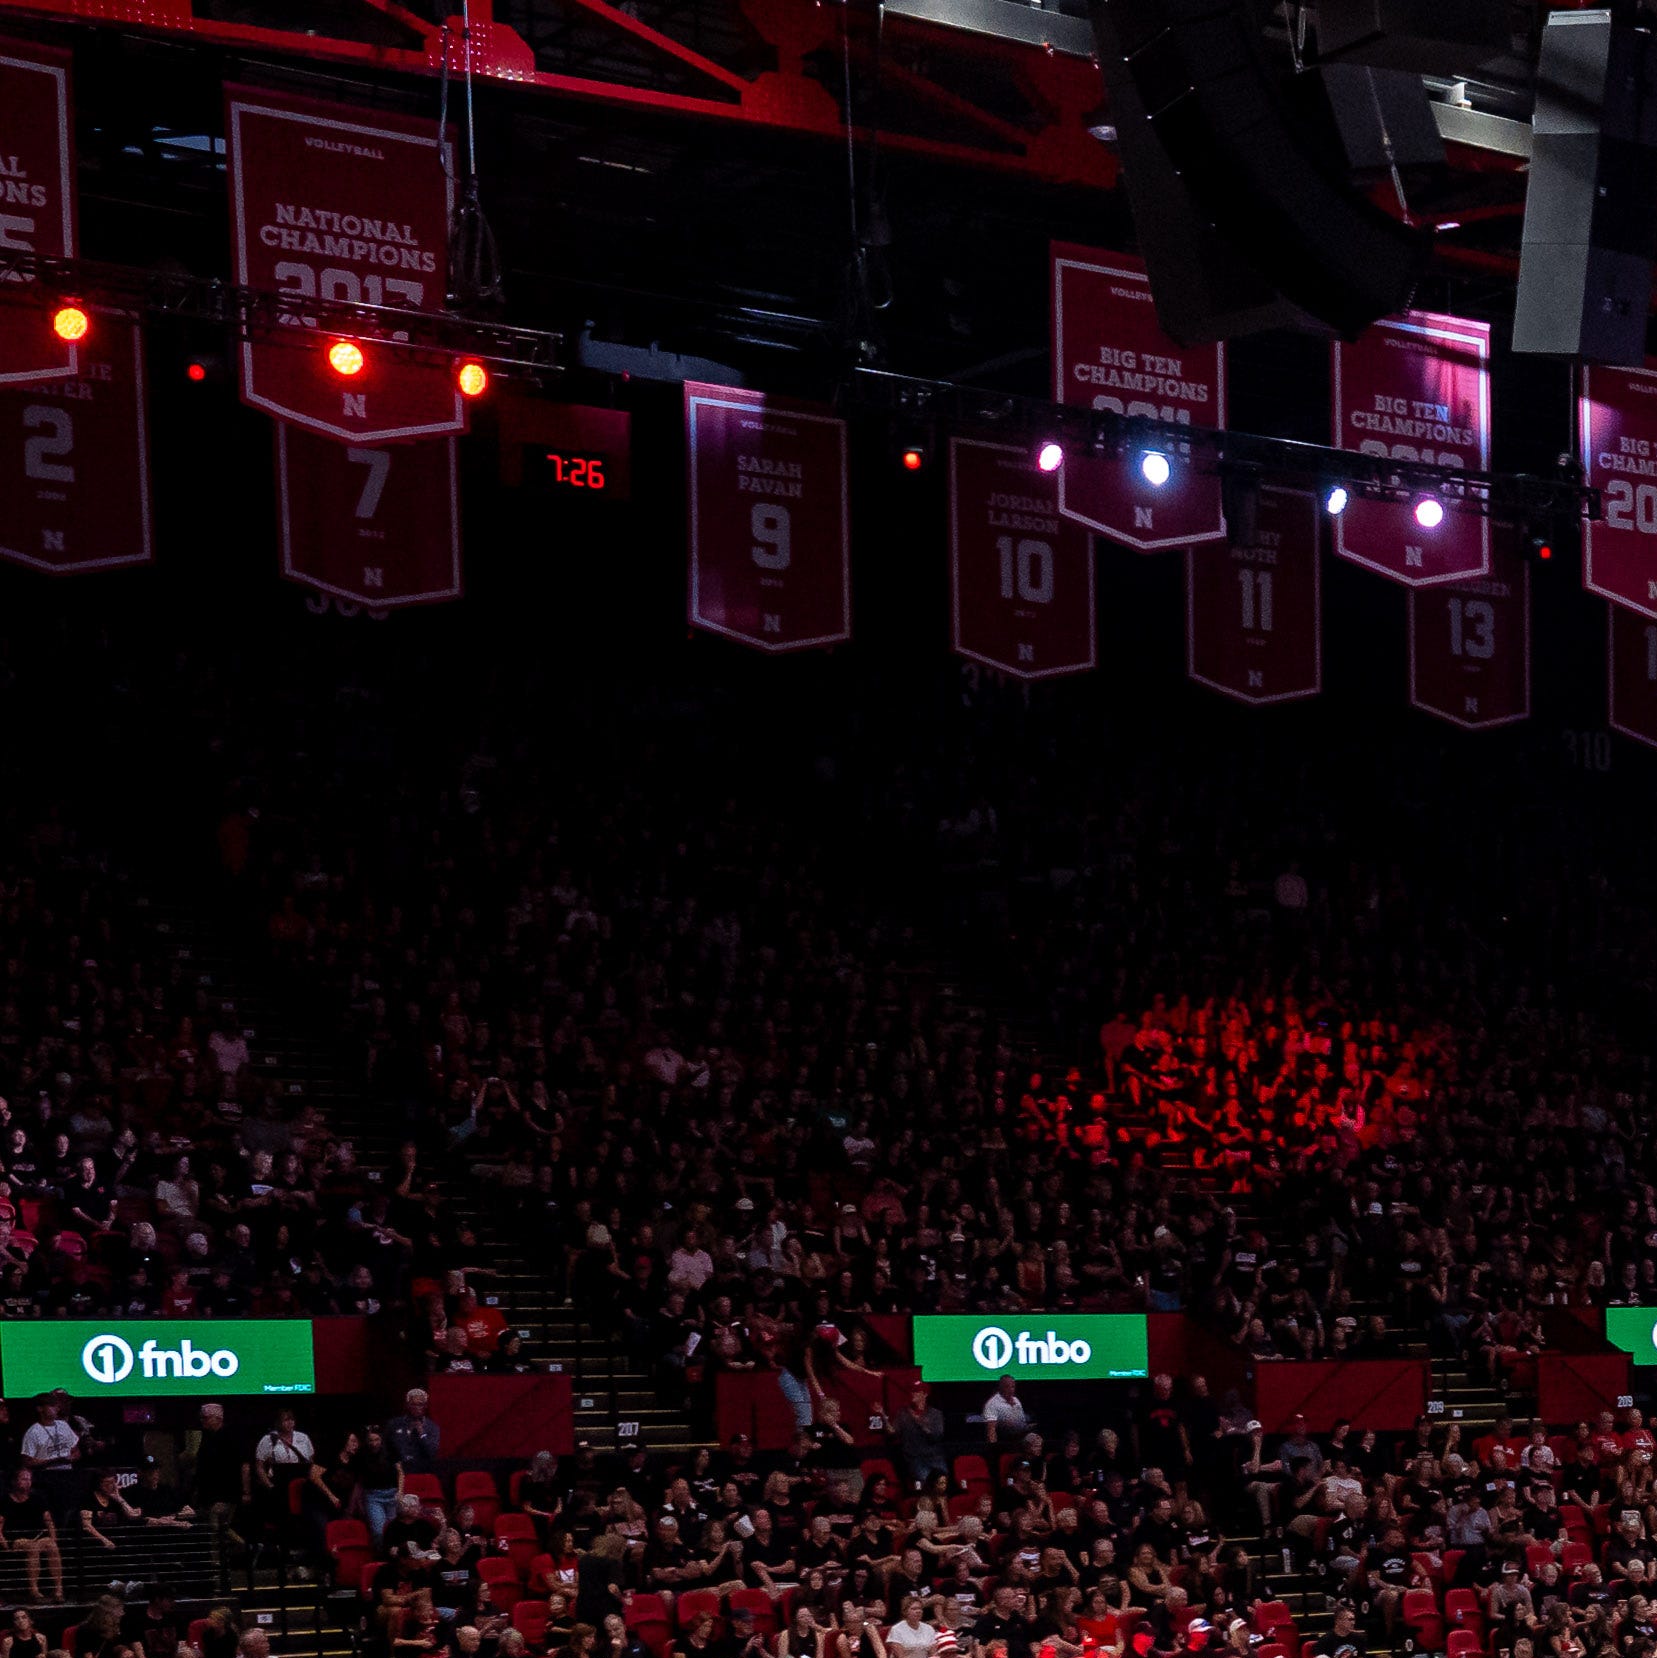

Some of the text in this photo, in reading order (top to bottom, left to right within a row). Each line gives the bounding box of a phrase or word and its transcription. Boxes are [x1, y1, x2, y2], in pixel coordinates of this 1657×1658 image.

[304, 136, 385, 161] VOLLEYBALL
[275, 202, 419, 246] NATIONAL
[259, 223, 437, 273] CHAMPIONS
[1099, 346, 1182, 377] BIG TEN
[1073, 362, 1209, 402] CHAMPIONS
[342, 392, 367, 419] N
[1374, 395, 1450, 423] BIG TEN
[22, 404, 75, 483] 2
[1351, 410, 1474, 446] CHAMPIONS
[1619, 436, 1651, 458] BIG
[347, 446, 391, 519] 7
[546, 454, 606, 490] 7:26
[736, 454, 803, 480] SARAH
[737, 476, 803, 499] PAVAN
[1133, 505, 1153, 529] N
[750, 502, 792, 571] 9
[995, 535, 1055, 605] 10
[1404, 545, 1423, 568] N
[1239, 568, 1273, 632] 11
[1449, 597, 1496, 660] 13
[139, 1340, 238, 1377] fnbo
[1015, 1332, 1090, 1364] fnbo
[618, 1422, 639, 1436] 207
